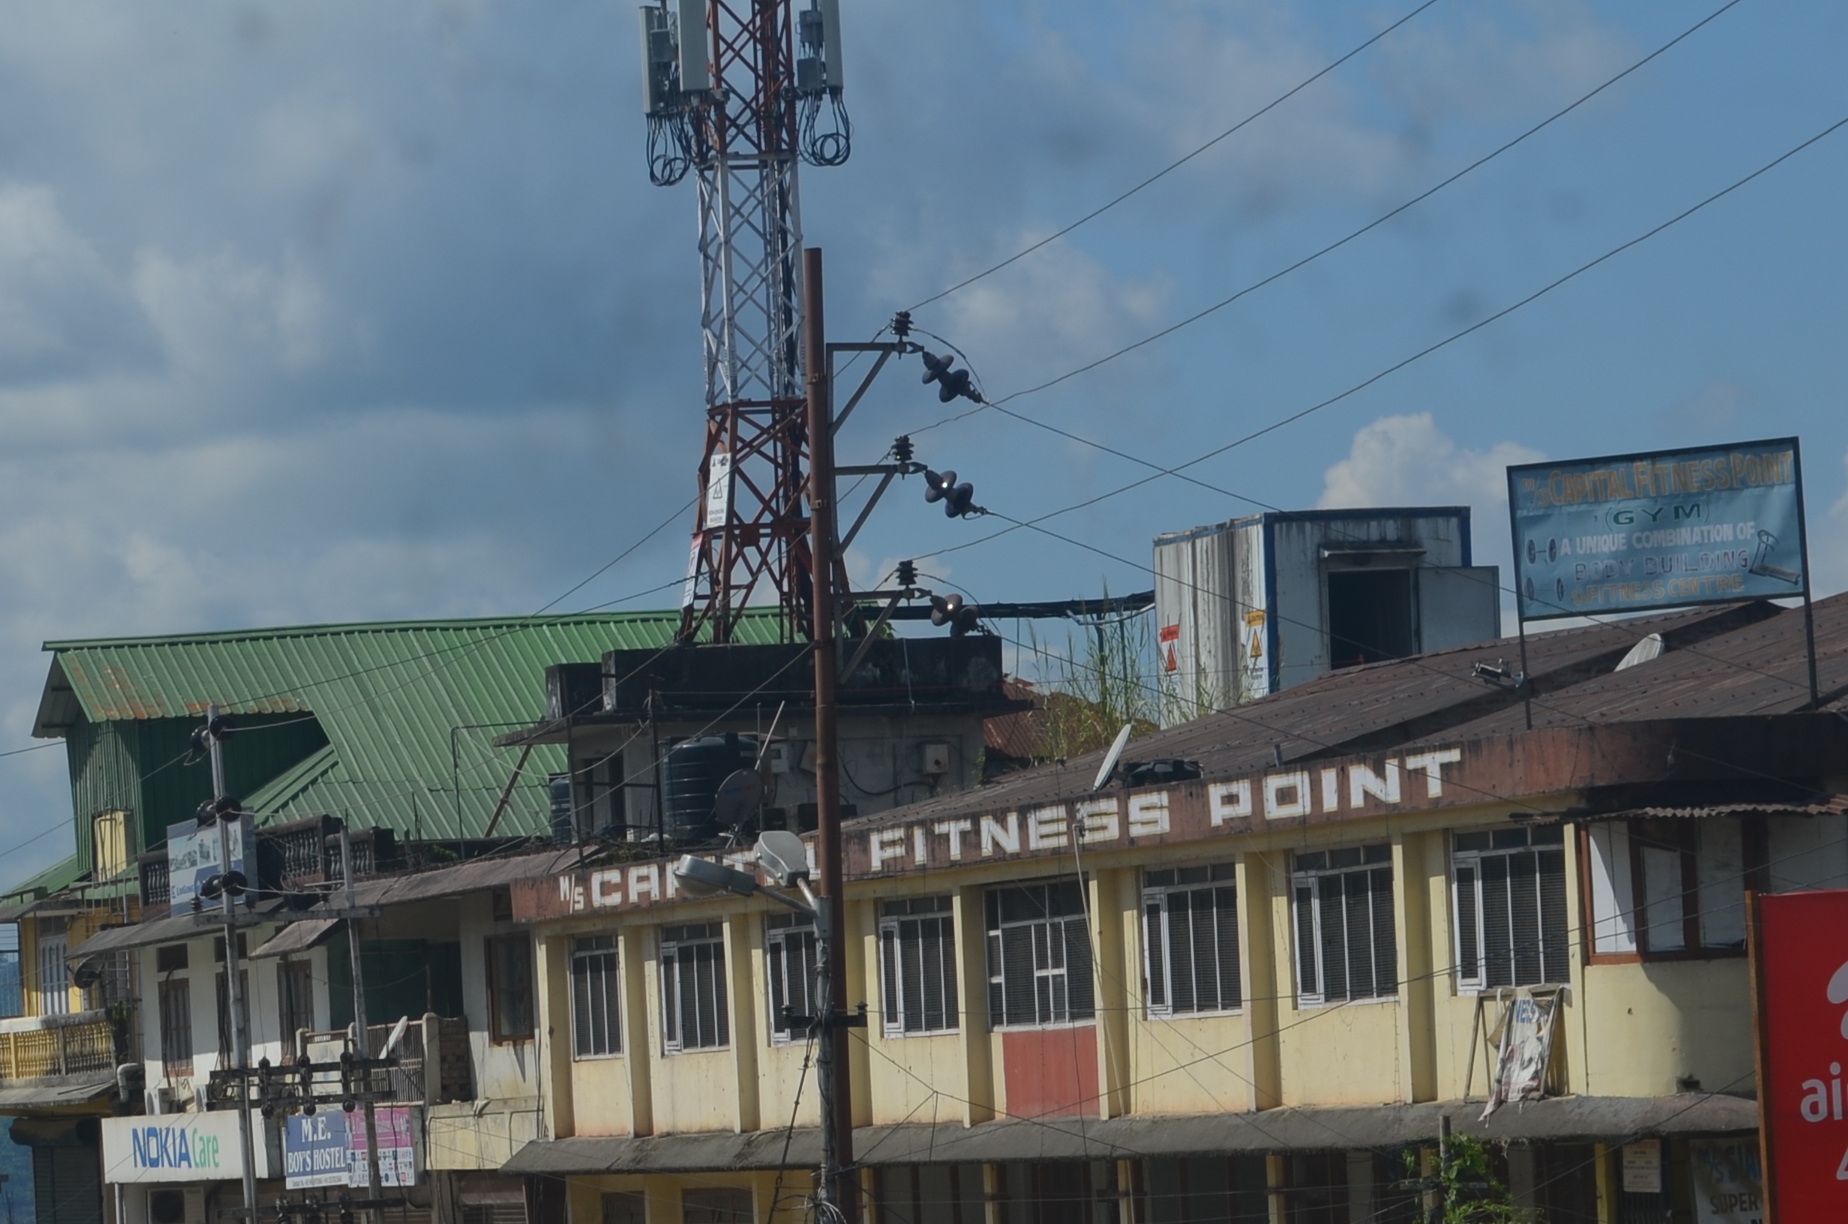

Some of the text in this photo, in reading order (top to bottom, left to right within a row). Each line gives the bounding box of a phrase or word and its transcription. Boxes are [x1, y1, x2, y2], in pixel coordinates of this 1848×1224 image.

[1550, 466, 1633, 506] CAPITAL
[1633, 459, 1730, 497] FITNESS
[1730, 450, 1793, 488] POINT
[1560, 522, 1755, 556] A UNIQUE COMBINATION OF
[1574, 549, 1750, 581] BODY BUILDING
[1667, 573, 1745, 599] CENTRE
[869, 790, 1170, 871] FITNESS
[1209, 748, 1461, 828] POINT
[301, 1116, 331, 1142] M.E.
[132, 1127, 219, 1168] NOKIA Care
[287, 1150, 311, 1173] BOY'S
[313, 1147, 346, 1170] HOSTEL
[1710, 1191, 1760, 1215] SUPER
